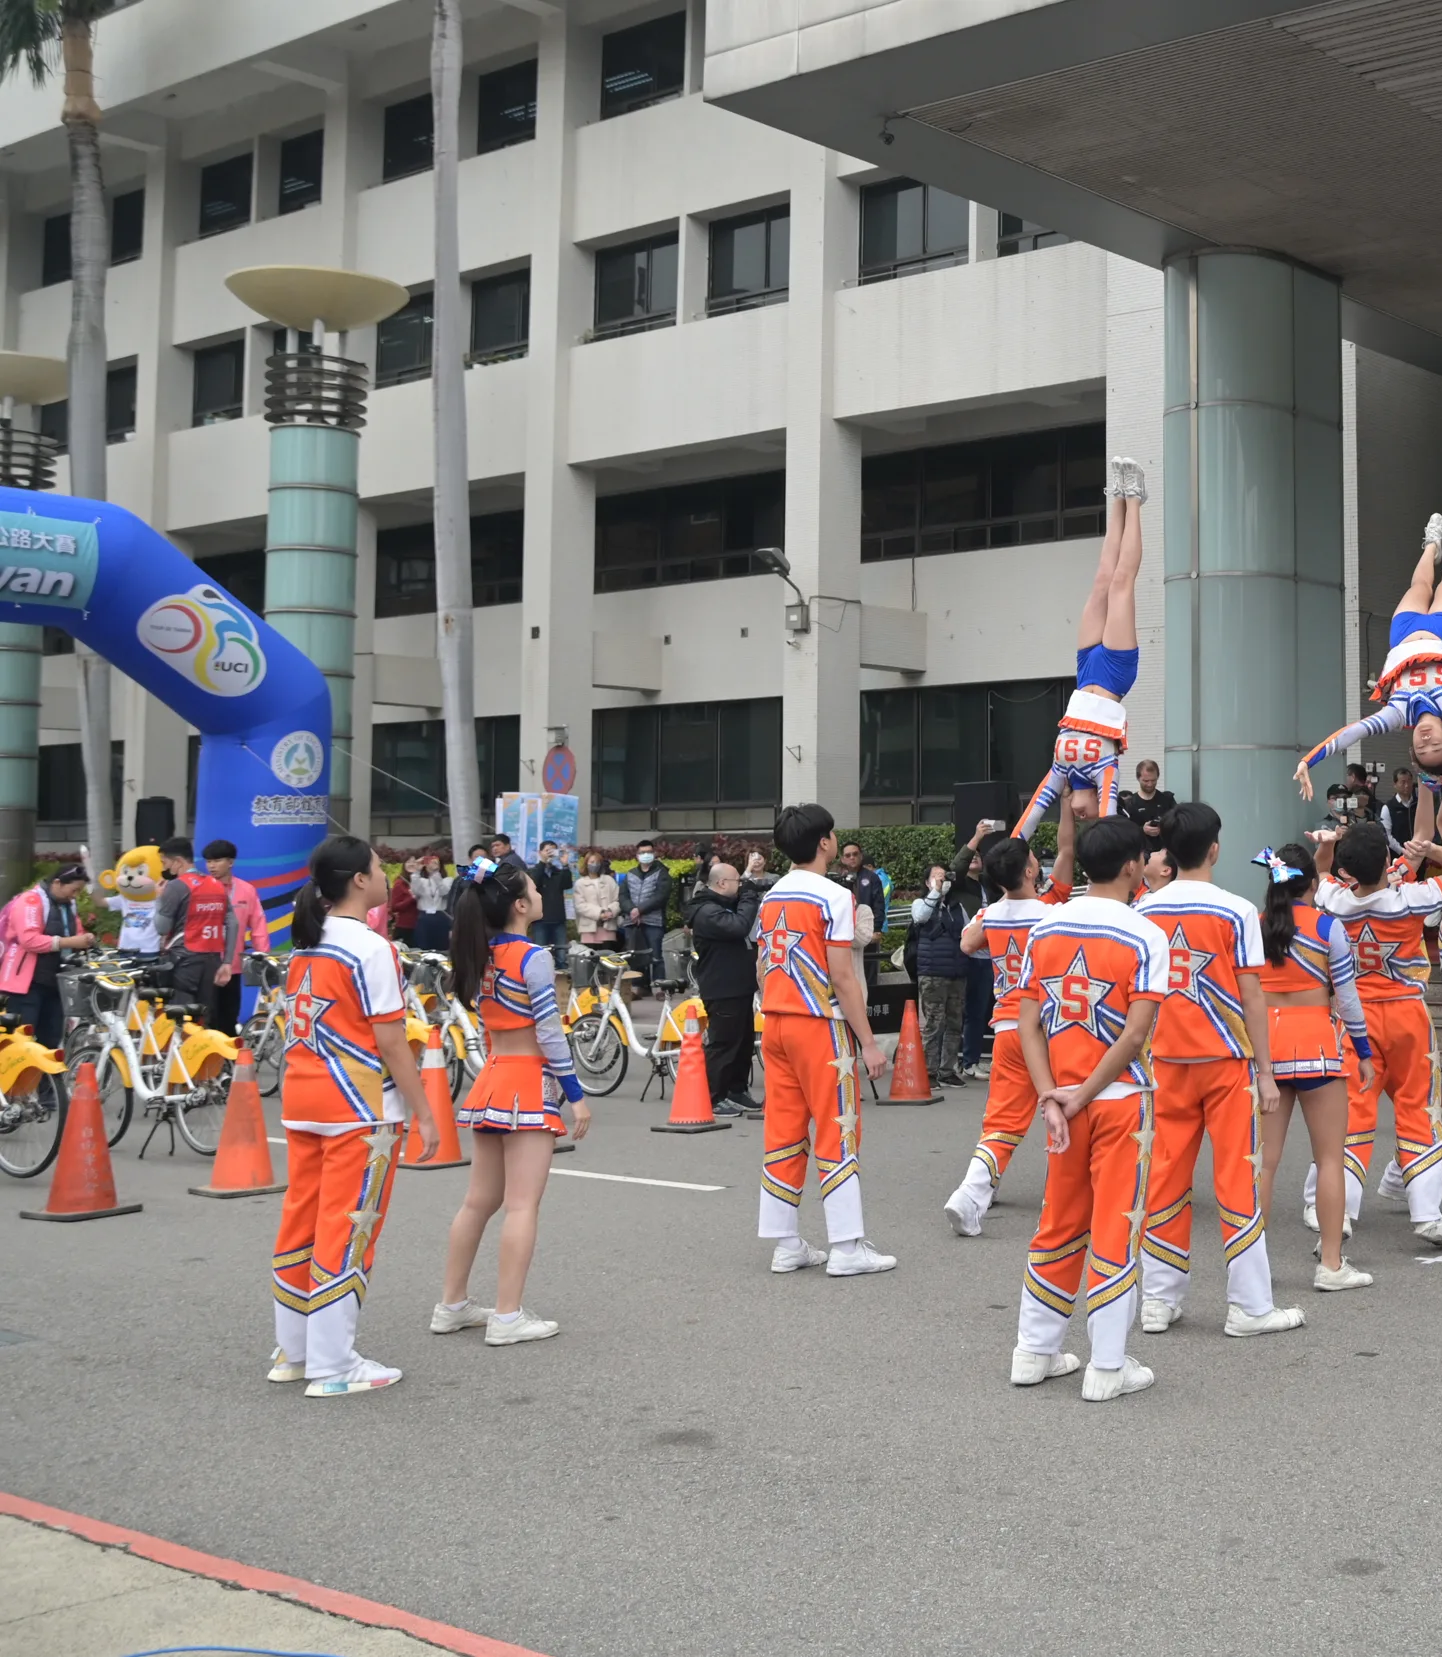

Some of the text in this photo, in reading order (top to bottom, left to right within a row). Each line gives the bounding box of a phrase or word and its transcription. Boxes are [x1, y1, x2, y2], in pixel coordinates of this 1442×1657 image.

[221, 662, 248, 673] UCI
[202, 925, 219, 939] 51
[770, 929, 788, 964] S
[1005, 953, 1022, 984] S
[1168, 948, 1192, 989] S
[1358, 941, 1383, 970] S
[1061, 974, 1090, 1022] S
[294, 994, 313, 1038] S
